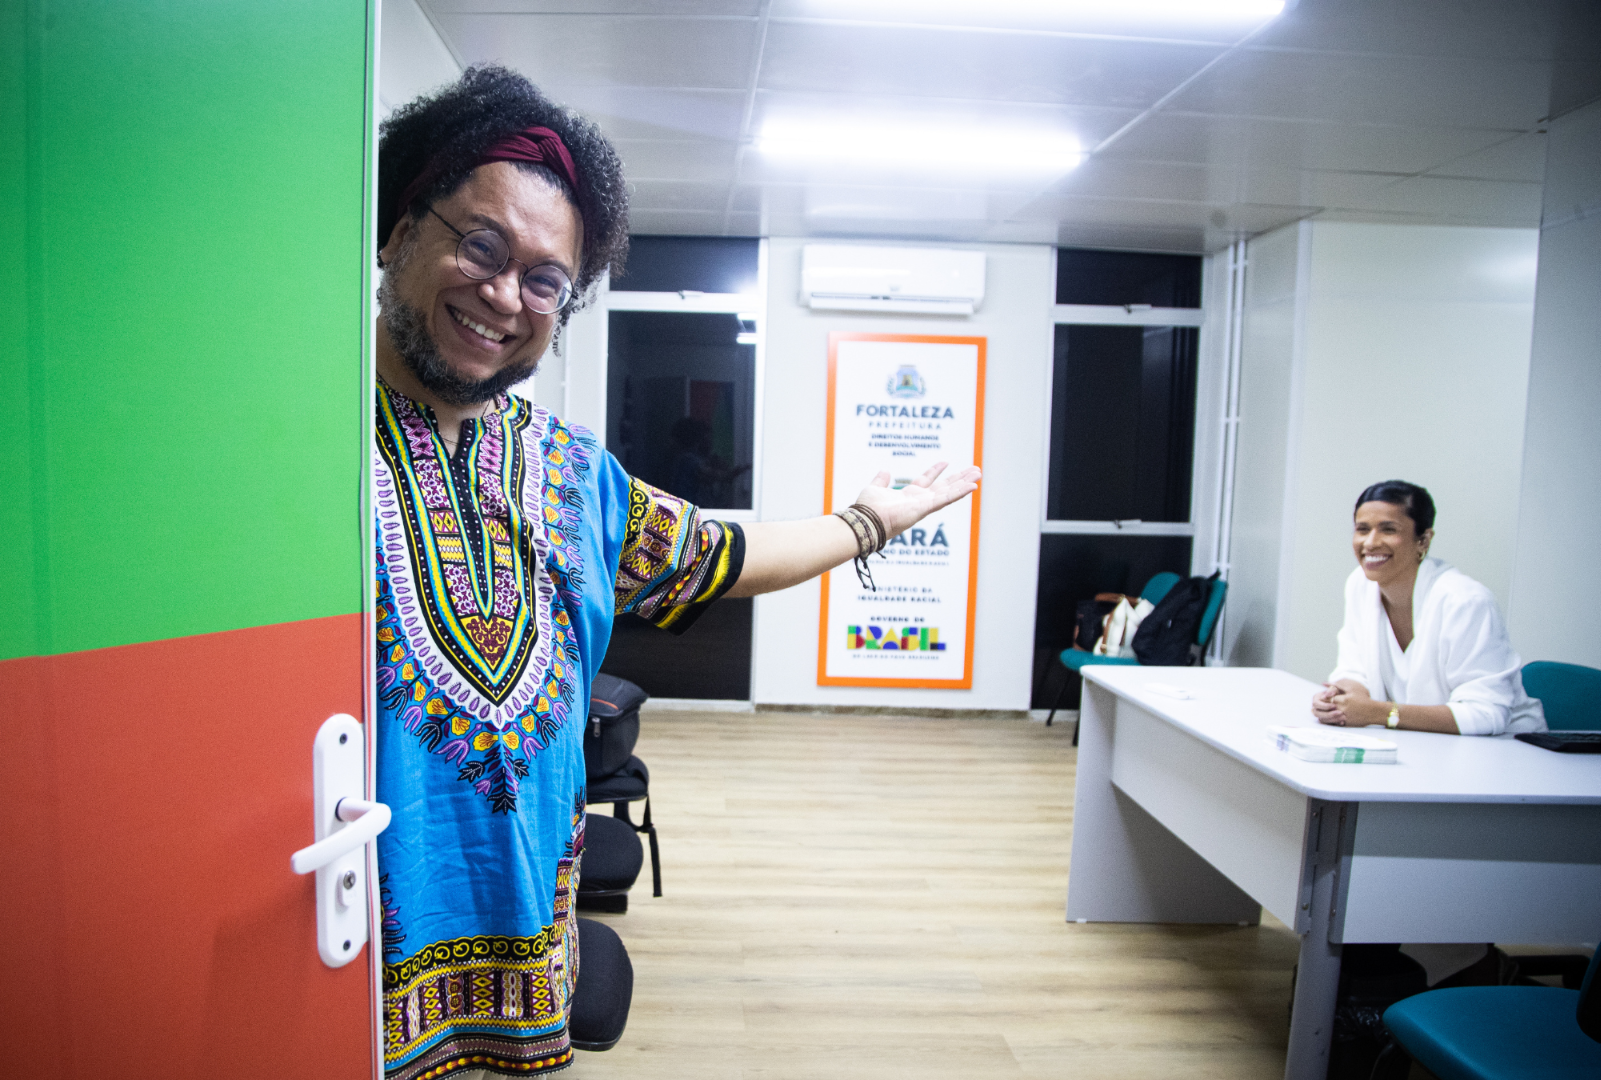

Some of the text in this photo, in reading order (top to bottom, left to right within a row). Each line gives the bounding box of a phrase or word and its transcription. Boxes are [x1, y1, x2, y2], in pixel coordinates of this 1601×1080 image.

[856, 404, 954, 419] FORTALEZA
[869, 421, 942, 430] PREFEITURA
[889, 522, 949, 547] ARÁ
[847, 625, 946, 651] BRASIL
